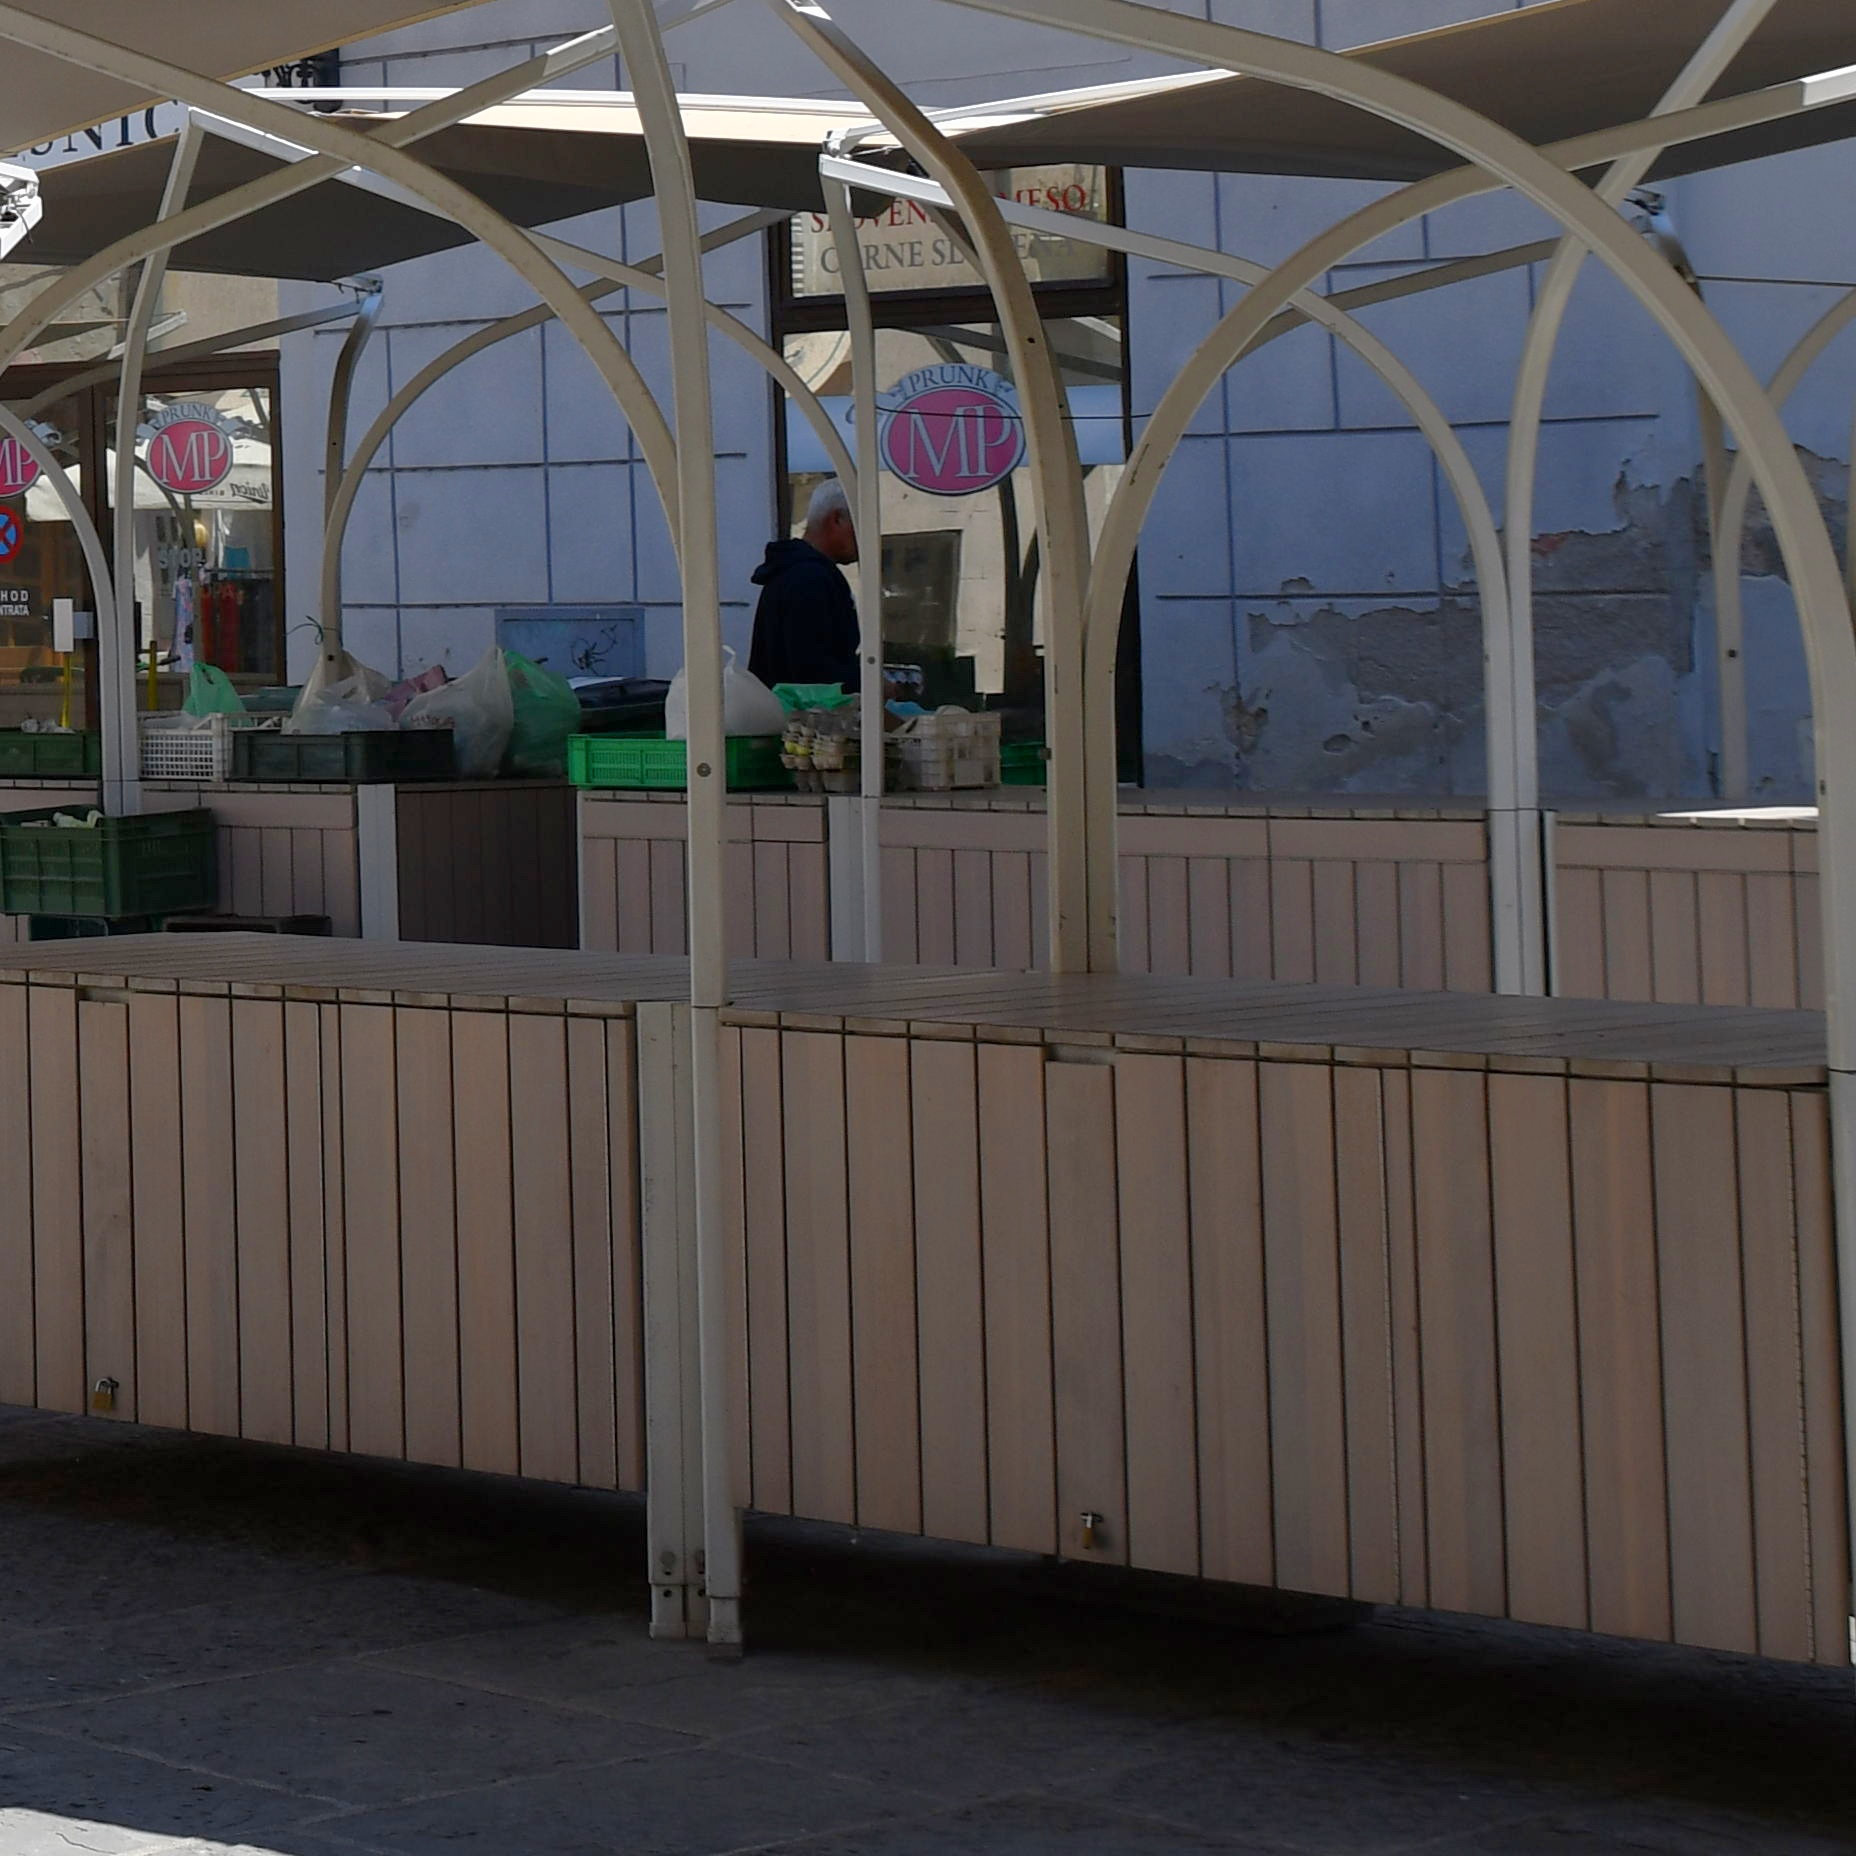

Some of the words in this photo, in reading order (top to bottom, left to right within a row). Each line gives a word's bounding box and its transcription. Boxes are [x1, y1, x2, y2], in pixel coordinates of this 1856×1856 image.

[820, 242, 924, 274] CRNE
[908, 366, 991, 393] PRUNK
[161, 404, 213, 425] PRUNK
[904, 404, 1012, 478] MP
[159, 430, 225, 485] MP
